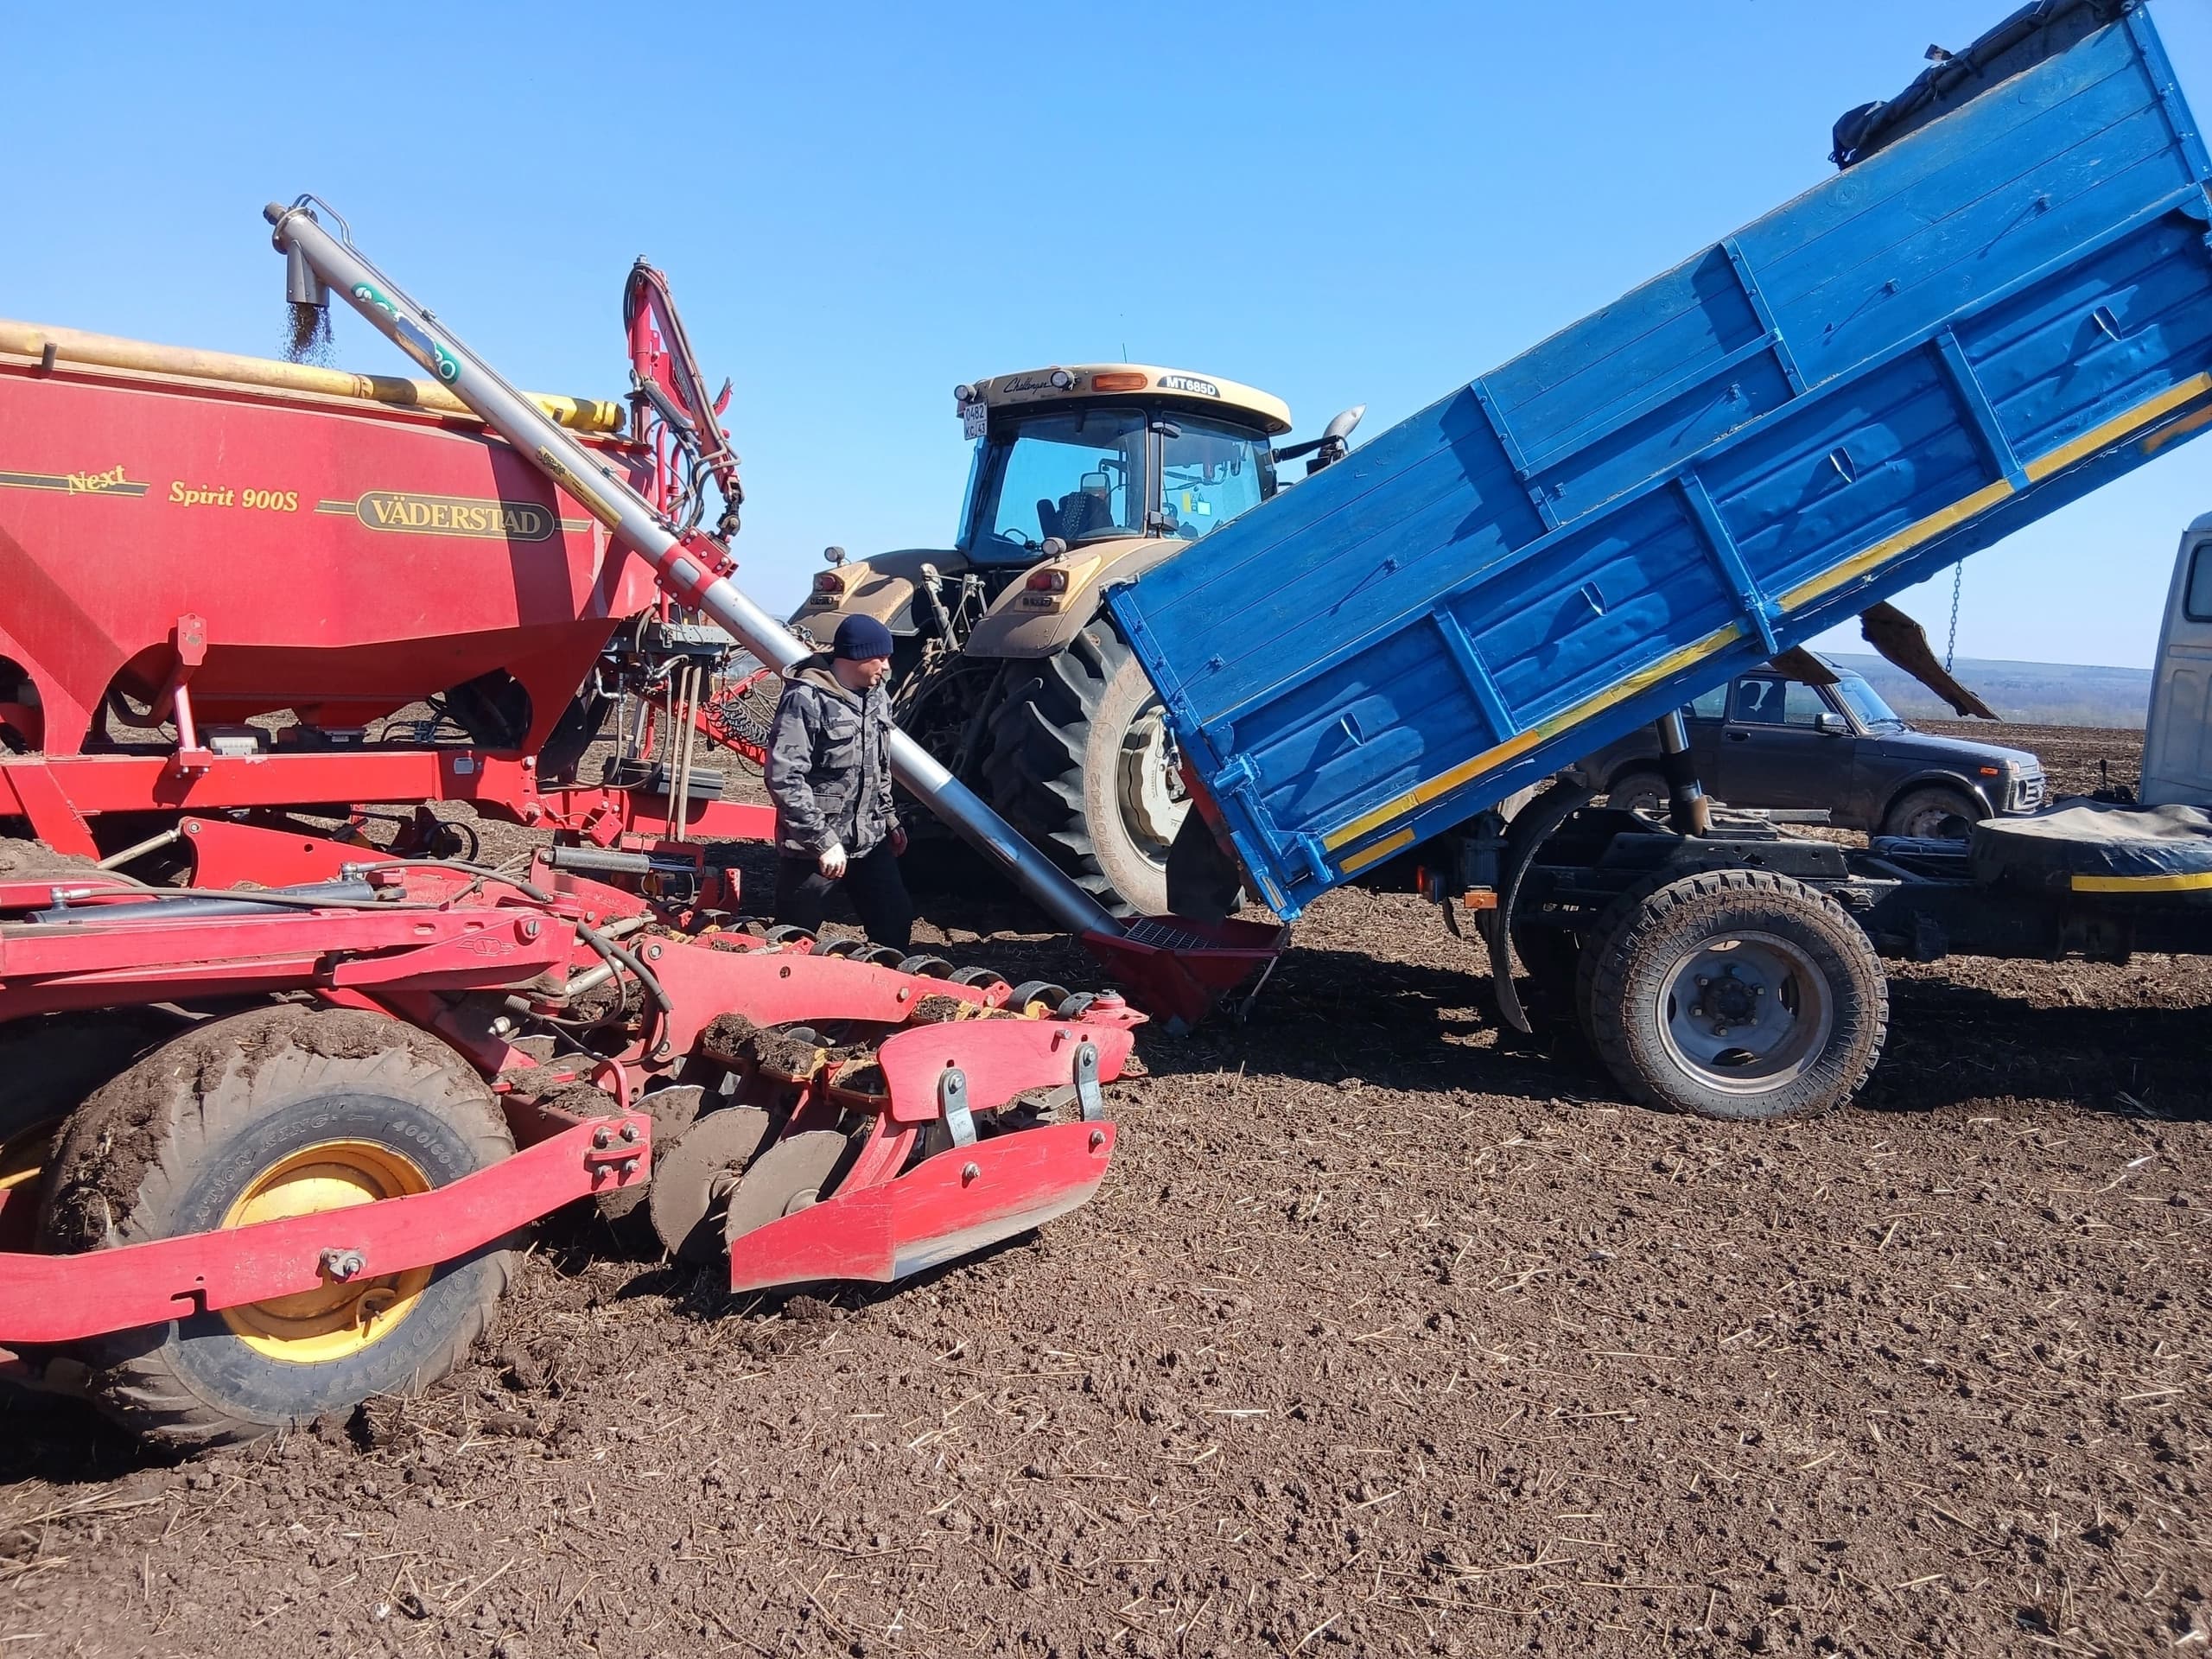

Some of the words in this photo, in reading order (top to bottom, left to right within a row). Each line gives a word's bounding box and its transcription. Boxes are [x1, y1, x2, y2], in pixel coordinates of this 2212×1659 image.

[1166, 377, 1217, 396] MT685D
[966, 405, 984, 422] 0482
[978, 423, 986, 435] 43
[67, 464, 127, 495] Next
[168, 480, 235, 508] Spirit
[241, 487, 299, 512] 900S
[372, 495, 542, 534] VÄDERSTAD
